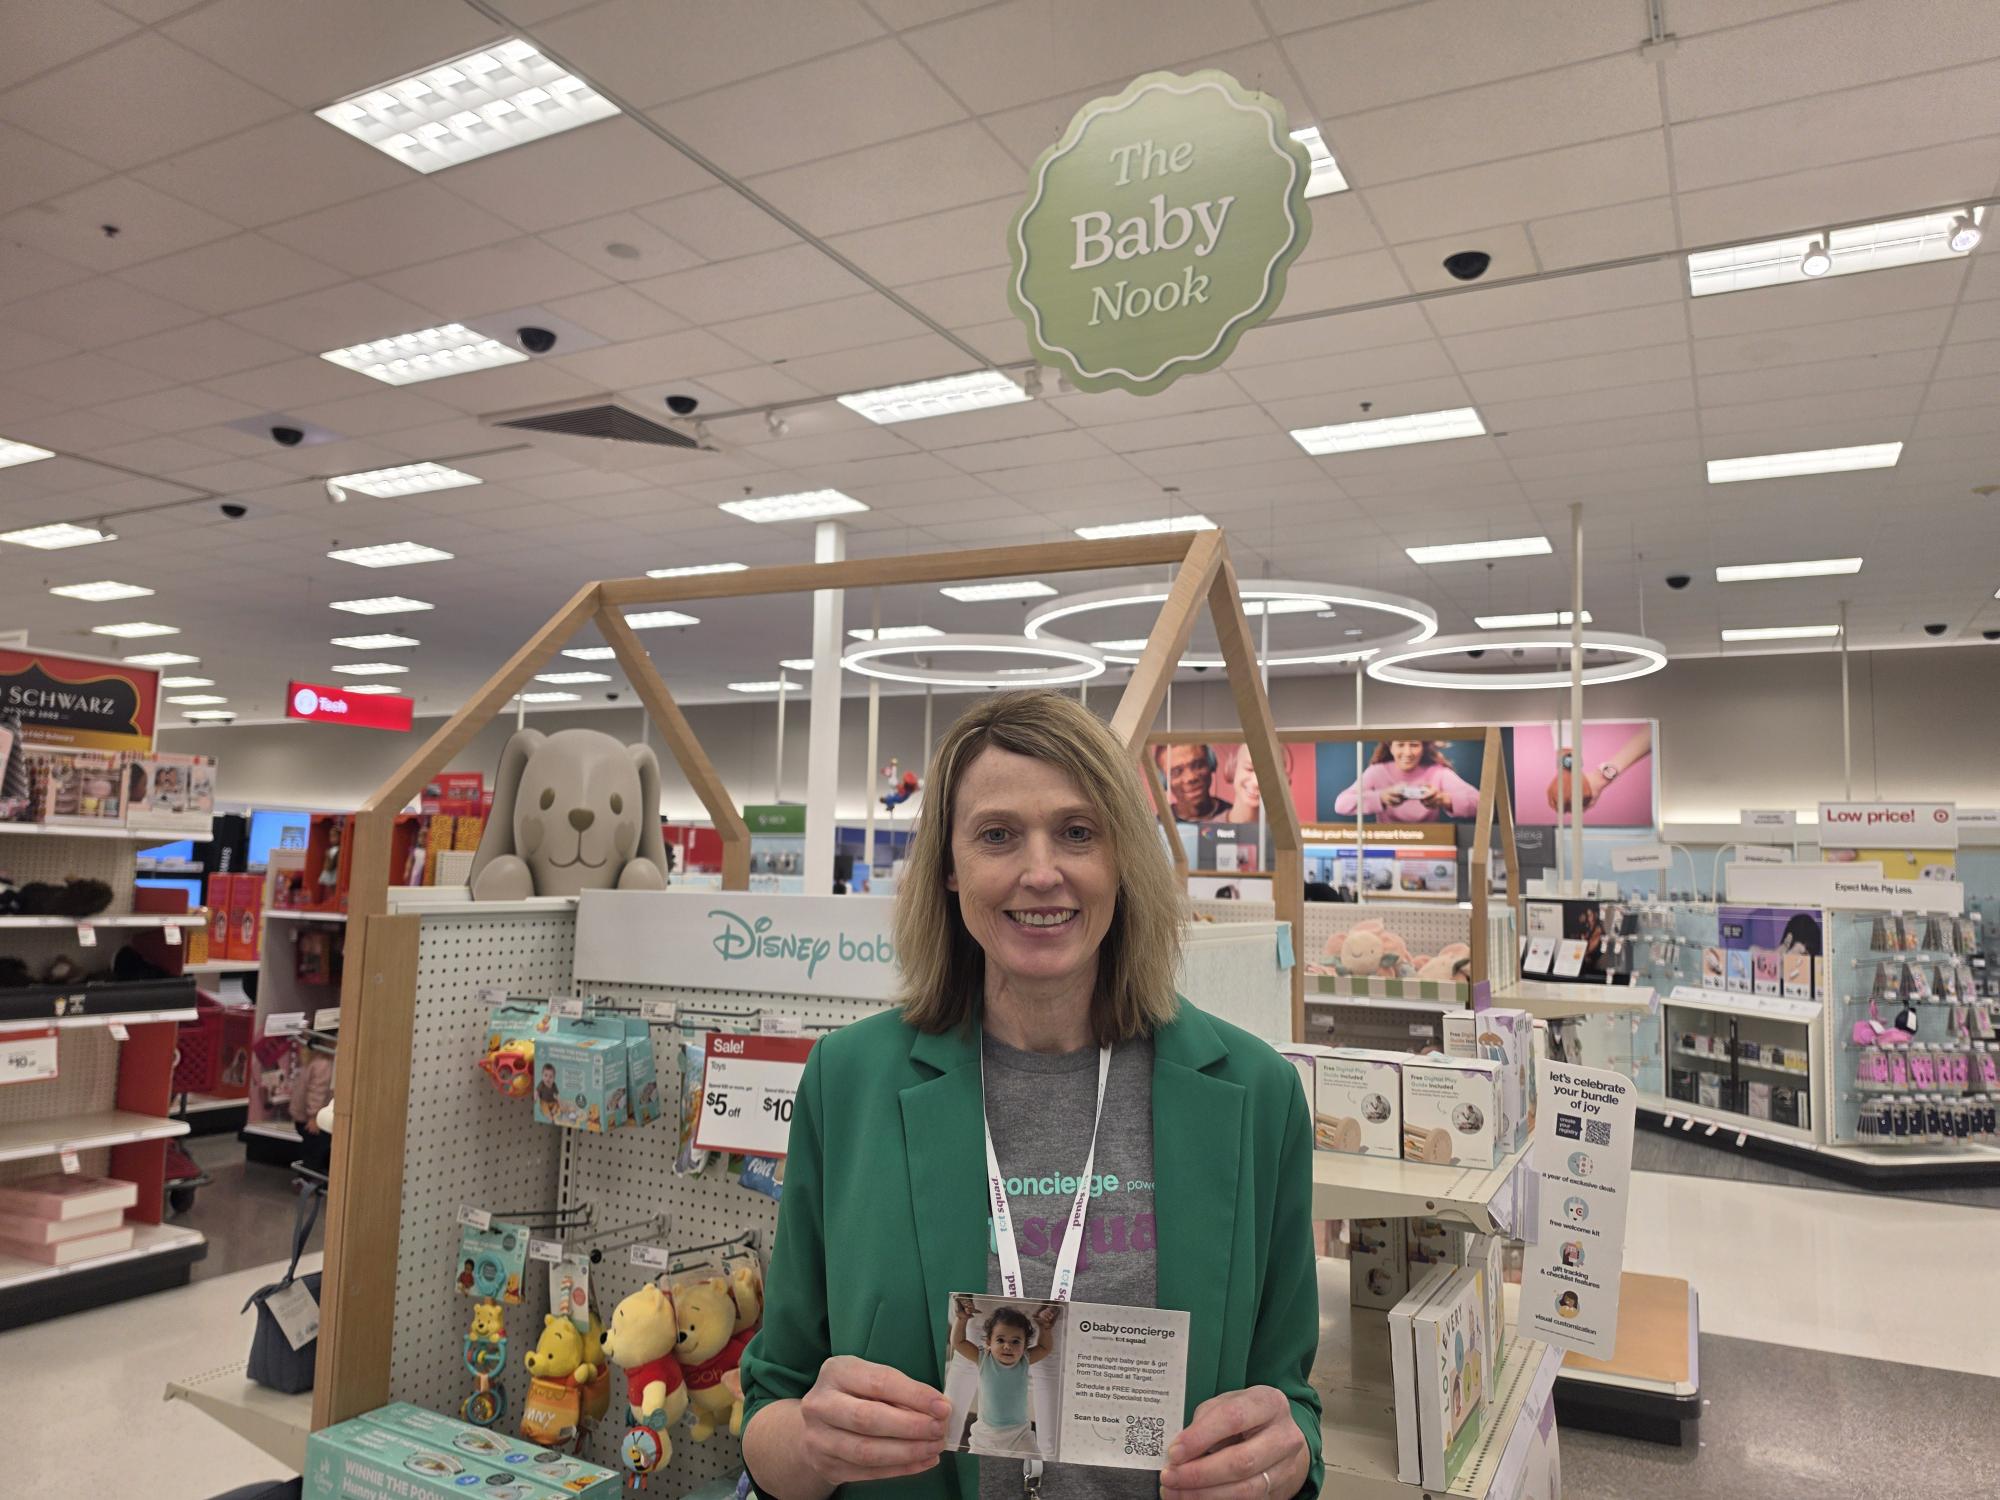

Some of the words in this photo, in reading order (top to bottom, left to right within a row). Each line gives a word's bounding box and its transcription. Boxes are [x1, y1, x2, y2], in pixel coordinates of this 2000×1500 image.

[1109, 138, 1195, 186] The
[1069, 193, 1236, 271] Baby
[1087, 264, 1211, 327] Nook
[8, 685, 115, 715] SCHWARZ
[1827, 808, 1862, 822] Low
[1867, 808, 1915, 825] price!
[1835, 881, 1859, 892] Expect
[1881, 885, 1894, 894] Pay
[708, 909, 831, 980] Disney
[838, 932, 897, 964] bab
[713, 1038, 744, 1054] Sale!
[711, 1061, 726, 1072] Toys
[1550, 1071, 1571, 1084] let's
[1574, 1077, 1626, 1094] celebrate
[1554, 1085, 1578, 1097] your
[1581, 1089, 1619, 1105] bundle
[706, 1092, 728, 1116] $5
[728, 1107, 741, 1118] off
[763, 1097, 794, 1122] $10
[1570, 1099, 1582, 1109] of
[1583, 1103, 1600, 1115] joy
[1558, 1127, 1578, 1136] registry
[1000, 1171, 1119, 1198] onciege
[1019, 1212, 1158, 1272] squa
[1092, 1321, 1119, 1334] baby
[1120, 1325, 1175, 1339] concierge
[1077, 1353, 1092, 1361] Find
[1093, 1354, 1103, 1362] the
[1104, 1356, 1118, 1364] right
[1119, 1358, 1134, 1366] baby
[1077, 1362, 1116, 1371] personalized
[1117, 1365, 1140, 1374] registry
[1142, 1367, 1165, 1375] support
[1076, 1369, 1091, 1377] from
[1104, 1371, 1123, 1380] Squad
[1076, 1382, 1104, 1391] Schedule
[1111, 1385, 1130, 1393] FREE
[1131, 1388, 1169, 1396] appointment
[1095, 1392, 1111, 1400] Baby
[1112, 1393, 1142, 1402] Specialist
[1101, 1416, 1120, 1424] Book
[343, 1458, 385, 1486] WINNIE
[386, 1475, 409, 1493] THE
